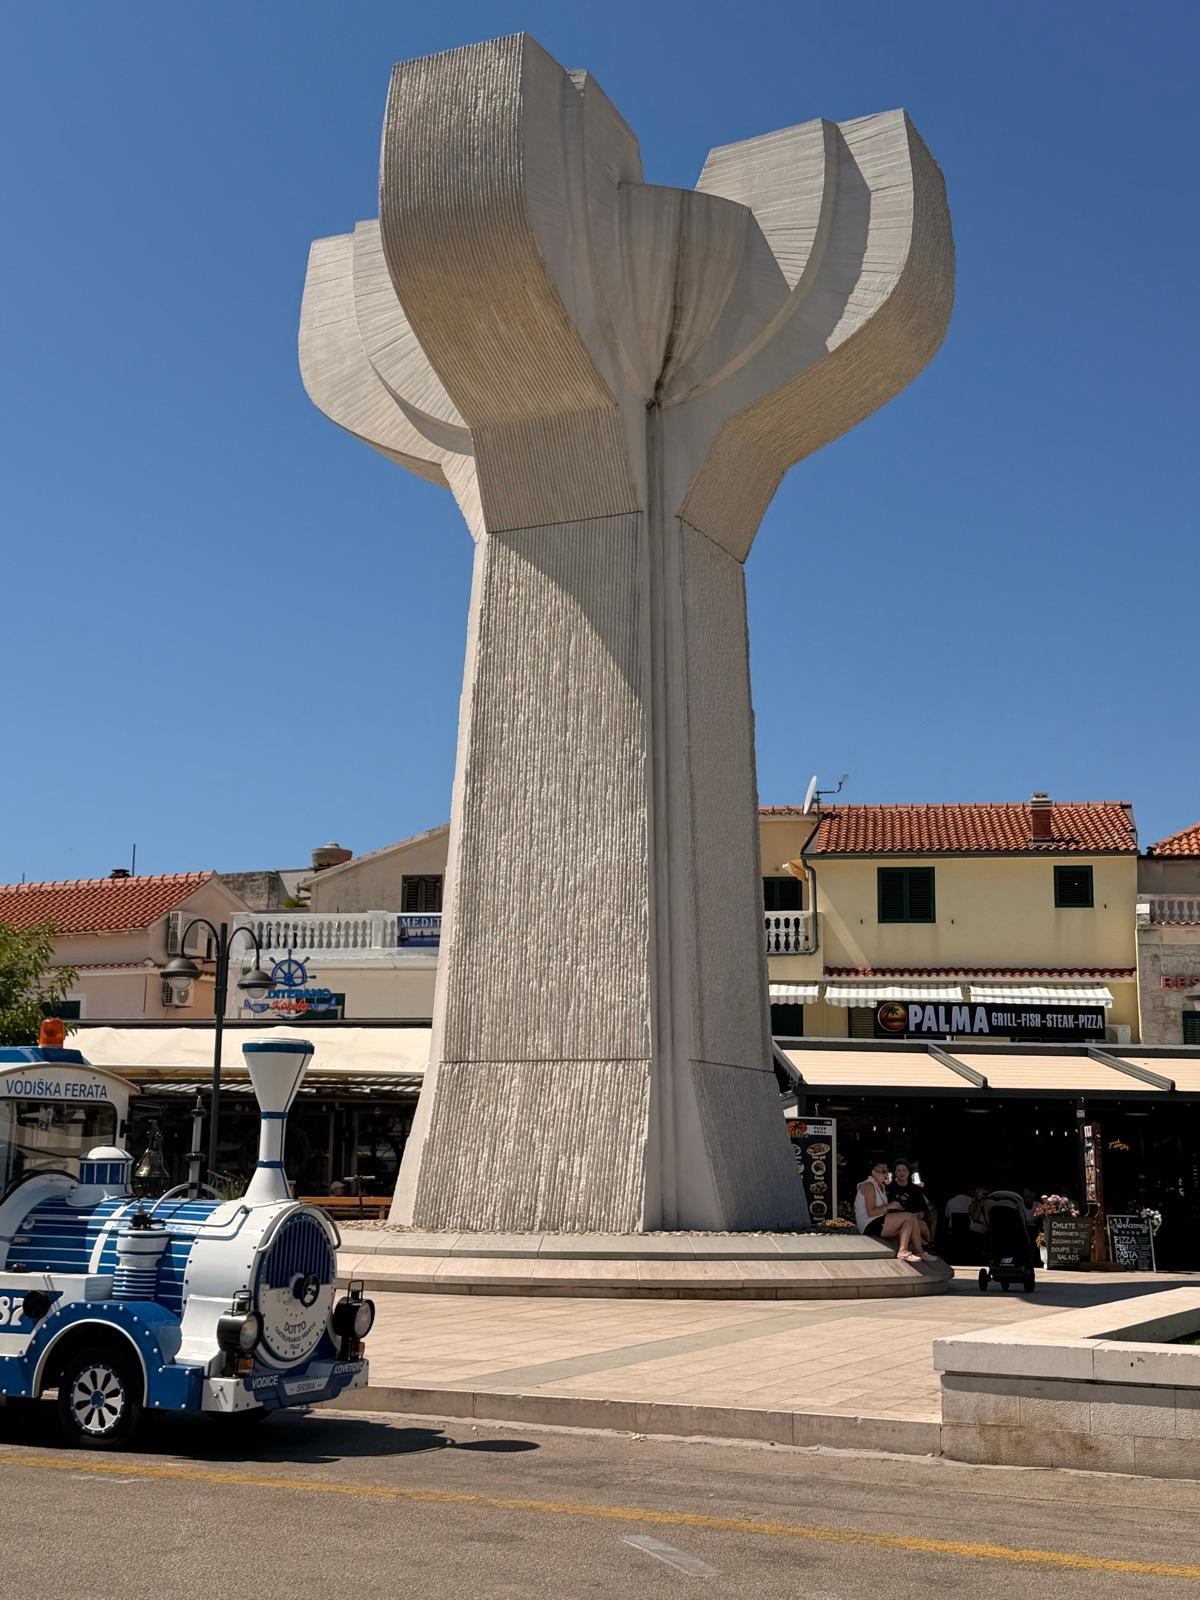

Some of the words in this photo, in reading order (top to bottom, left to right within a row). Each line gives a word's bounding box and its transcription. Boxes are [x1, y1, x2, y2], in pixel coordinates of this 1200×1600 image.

[908, 1004, 990, 1033] PALMA
[6, 1078, 62, 1097] VODIŠKA
[64, 1082, 108, 1098] FERATA
[1113, 1235, 1137, 1244] PIZZA
[1115, 1250, 1138, 1259] PASTA
[284, 1320, 307, 1335] DOTTO
[252, 1374, 280, 1390] VODICE
